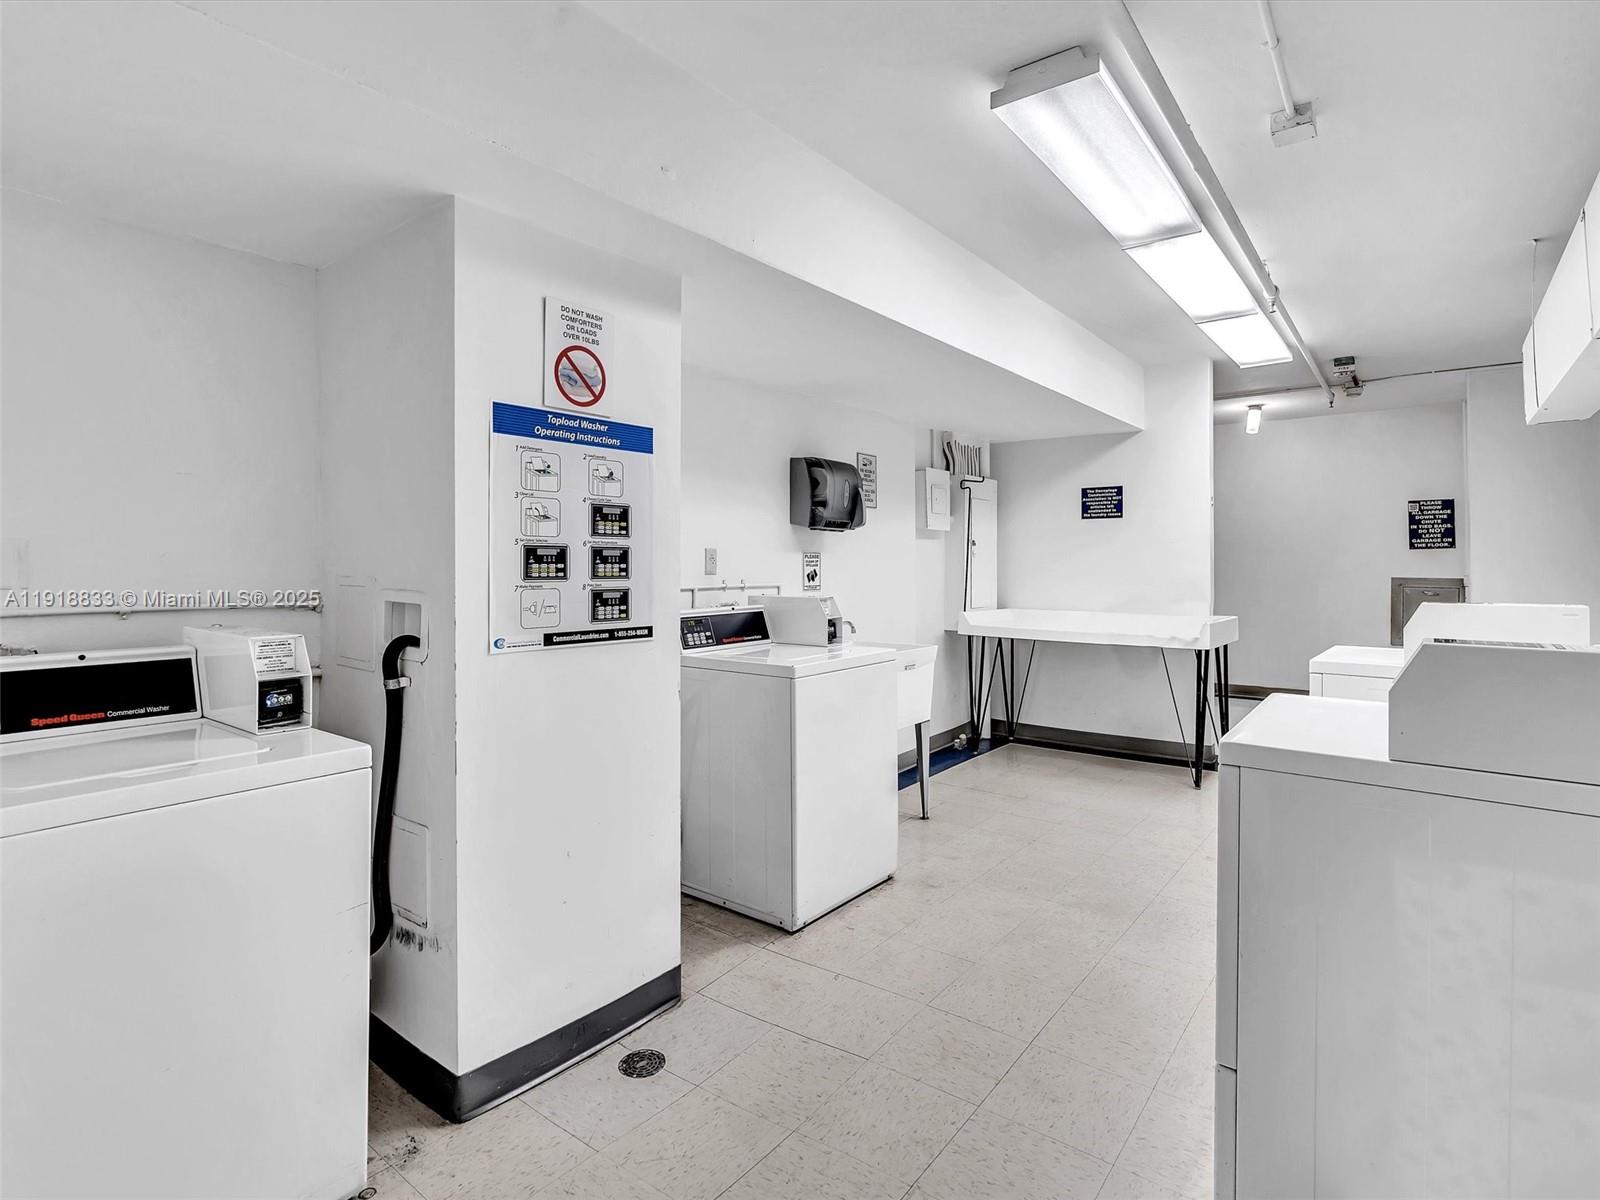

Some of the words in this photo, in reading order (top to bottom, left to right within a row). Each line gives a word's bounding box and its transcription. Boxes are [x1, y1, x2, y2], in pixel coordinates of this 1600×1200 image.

[561, 305, 570, 313] DO
[572, 308, 584, 317] NOT
[586, 312, 603, 322] WASH
[561, 314, 603, 331] COMFORTERS
[566, 324, 575, 332] OR
[577, 326, 597, 337] LOADS
[563, 332, 580, 341] OVER
[582, 336, 600, 346] 10LBS
[547, 414, 579, 428] Topload
[581, 420, 608, 432] Washer
[534, 426, 576, 441] Operating
[577, 433, 620, 446] Instructions
[553, 633, 609, 642] CommercialLaundries.com
[31, 715, 68, 727] Speed
[70, 711, 105, 722] Queen
[107, 706, 145, 718] Commercial
[147, 705, 170, 713] Washer
